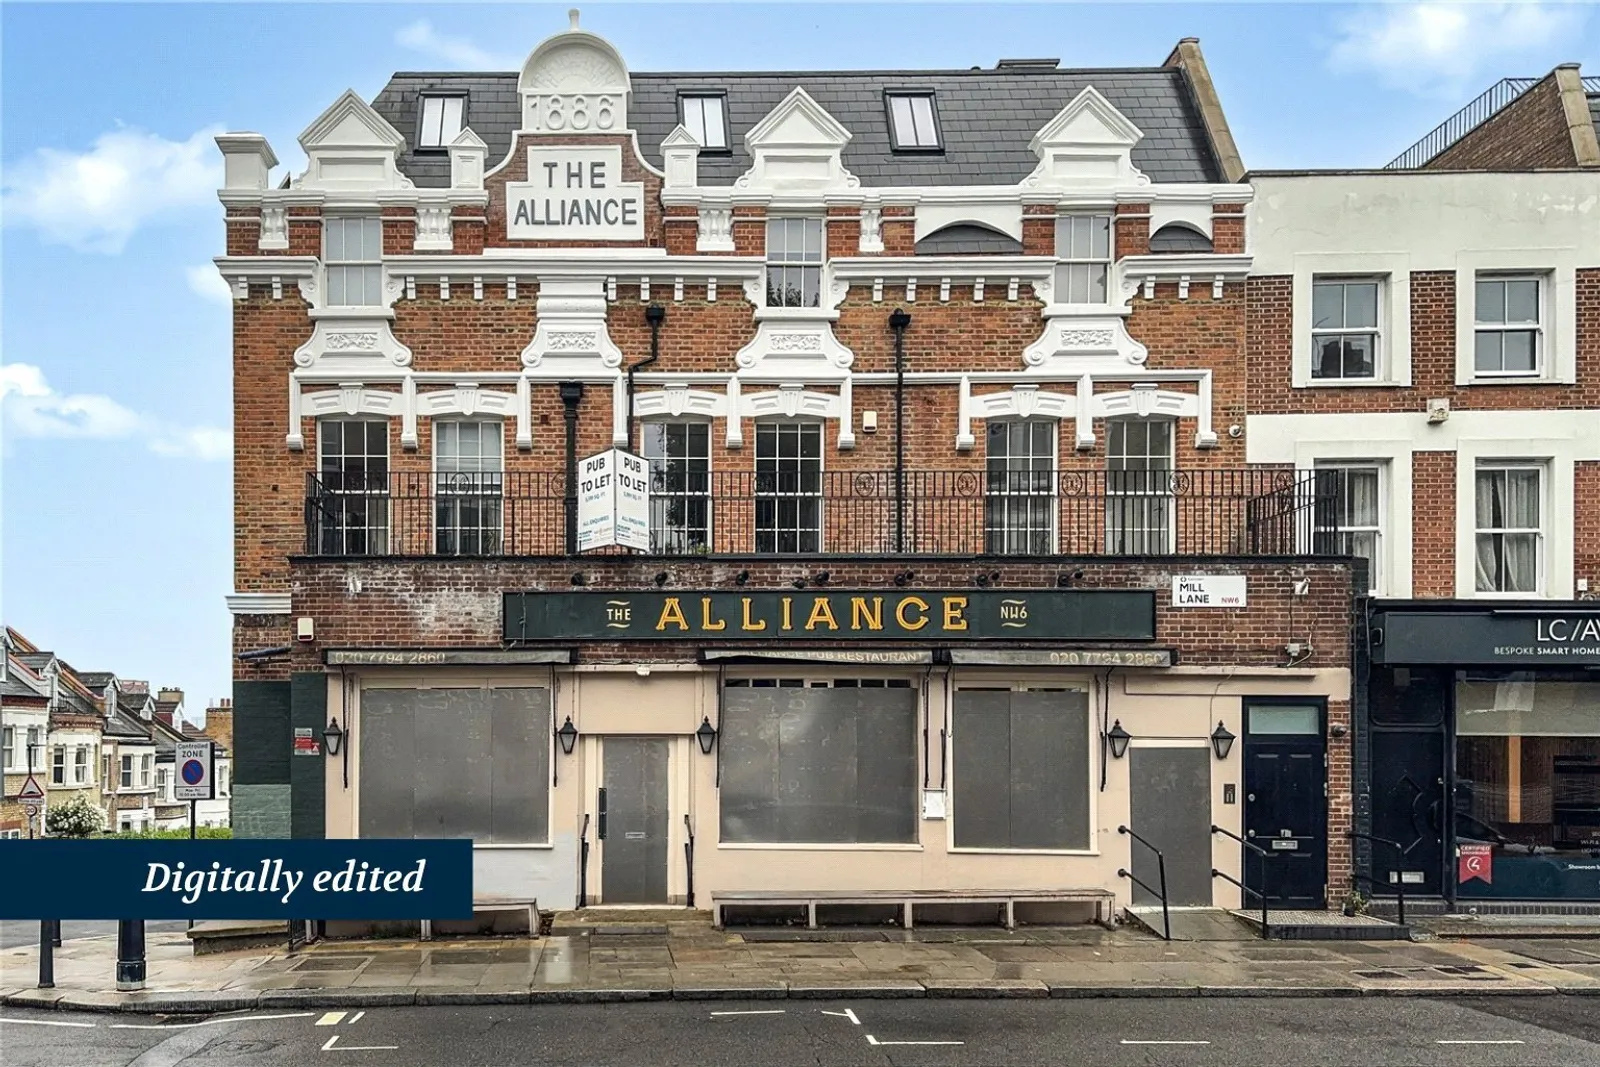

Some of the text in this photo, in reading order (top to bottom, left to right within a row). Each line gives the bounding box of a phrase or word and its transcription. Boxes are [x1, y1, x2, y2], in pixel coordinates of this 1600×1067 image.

[531, 95, 614, 130] 1886
[543, 162, 606, 188] THE
[514, 199, 638, 225] ALLIANCE
[587, 457, 606, 474] PUB
[624, 457, 641, 473] PUB
[581, 473, 611, 493] TO LET
[619, 473, 647, 493] TO LET
[1180, 583, 1205, 592] MILL
[1179, 594, 1210, 604] LANE
[606, 597, 1028, 631] THE ALLIANCE NW6
[335, 652, 446, 664] 020 7794 2860
[807, 651, 835, 660] PUB
[839, 651, 923, 662] RESTAURANT
[1050, 652, 1079, 665] 020
[1494, 647, 1535, 655] BESPOKE
[1537, 647, 1570, 655] SMART
[182, 750, 204, 758] ZONE
